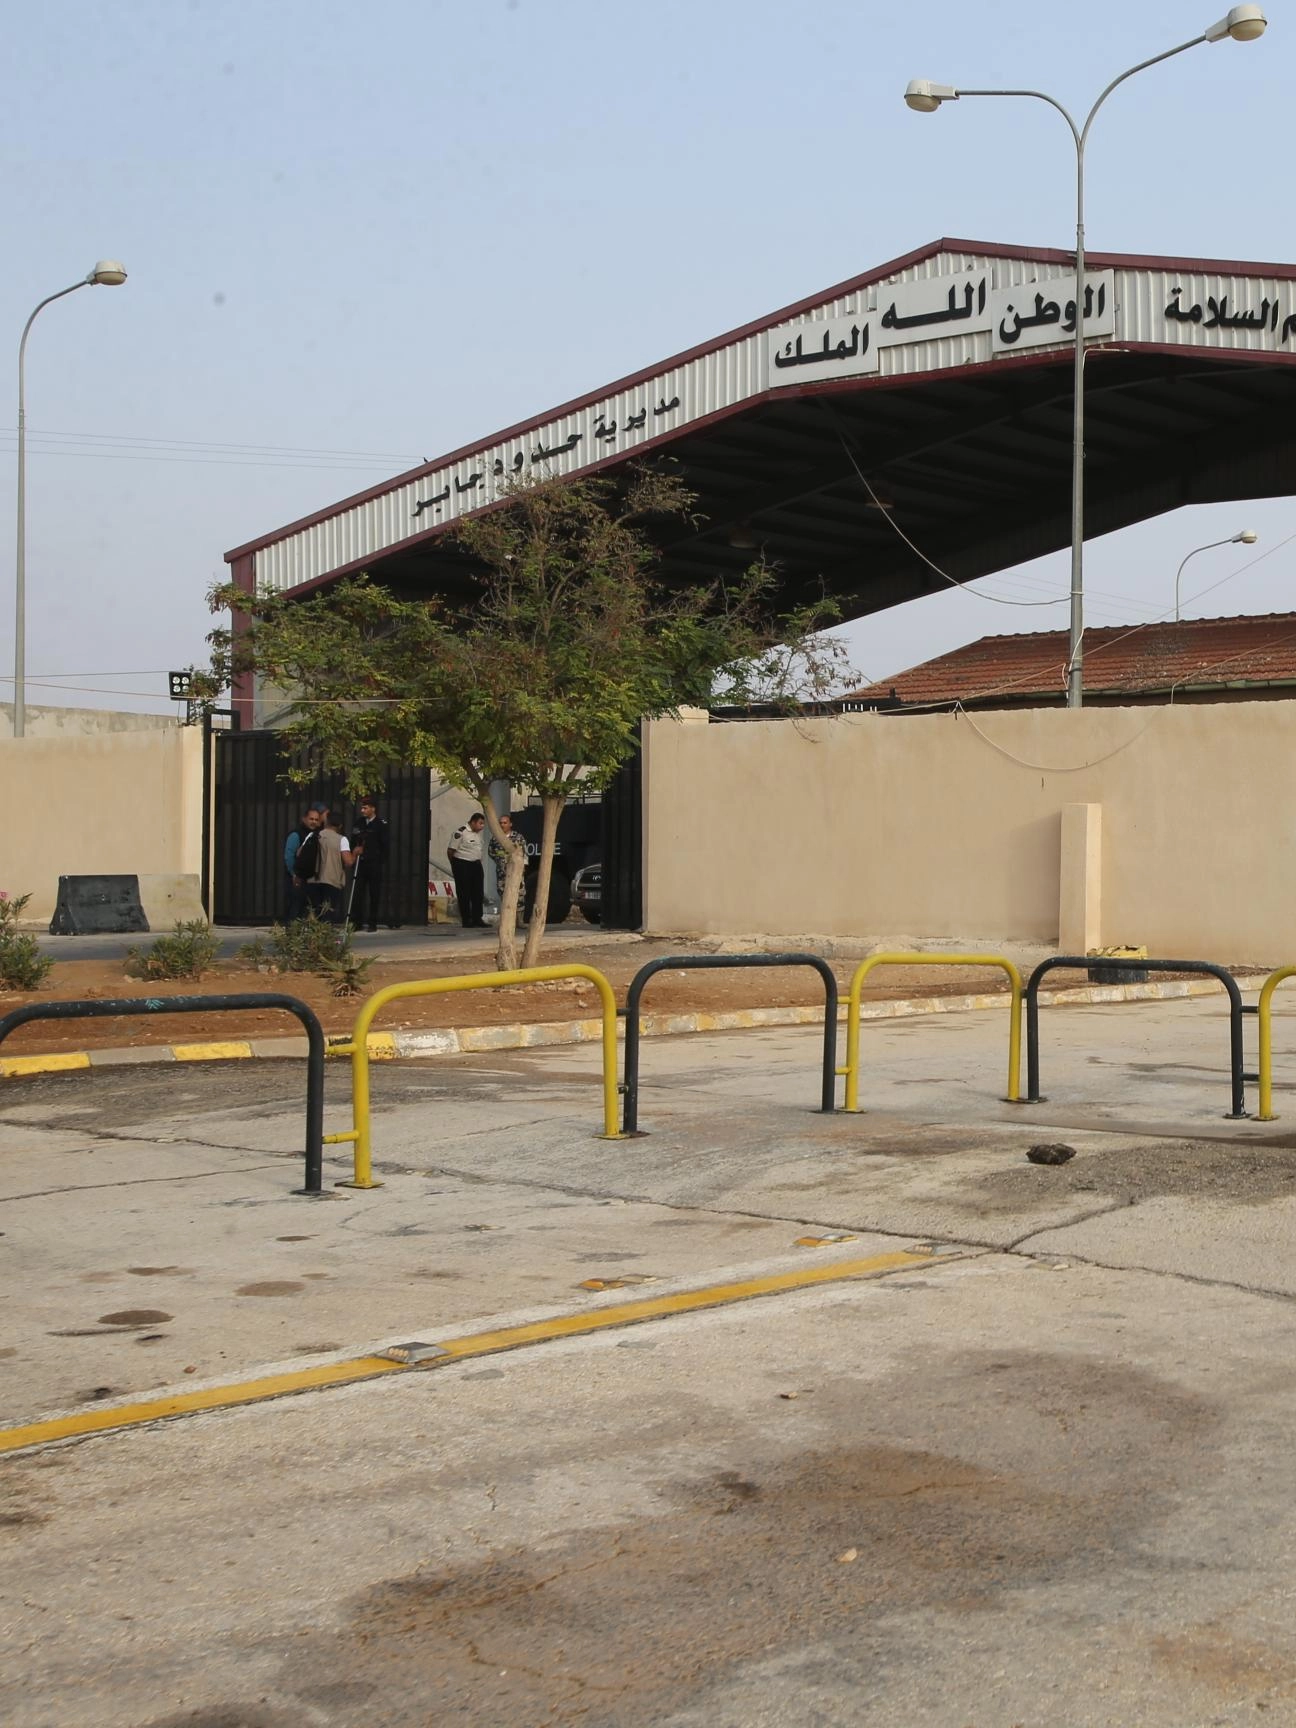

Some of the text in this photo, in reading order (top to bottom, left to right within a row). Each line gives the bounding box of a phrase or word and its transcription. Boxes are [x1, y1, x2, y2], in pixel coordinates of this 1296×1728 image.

[880, 276, 987, 330] الله
[999, 282, 1106, 344] الوطن
[1164, 286, 1279, 333] السلامة
[774, 321, 870, 369] الملك
[410, 395, 681, 517] مديرية حدود جابر
[526, 842, 561, 856] OLE
